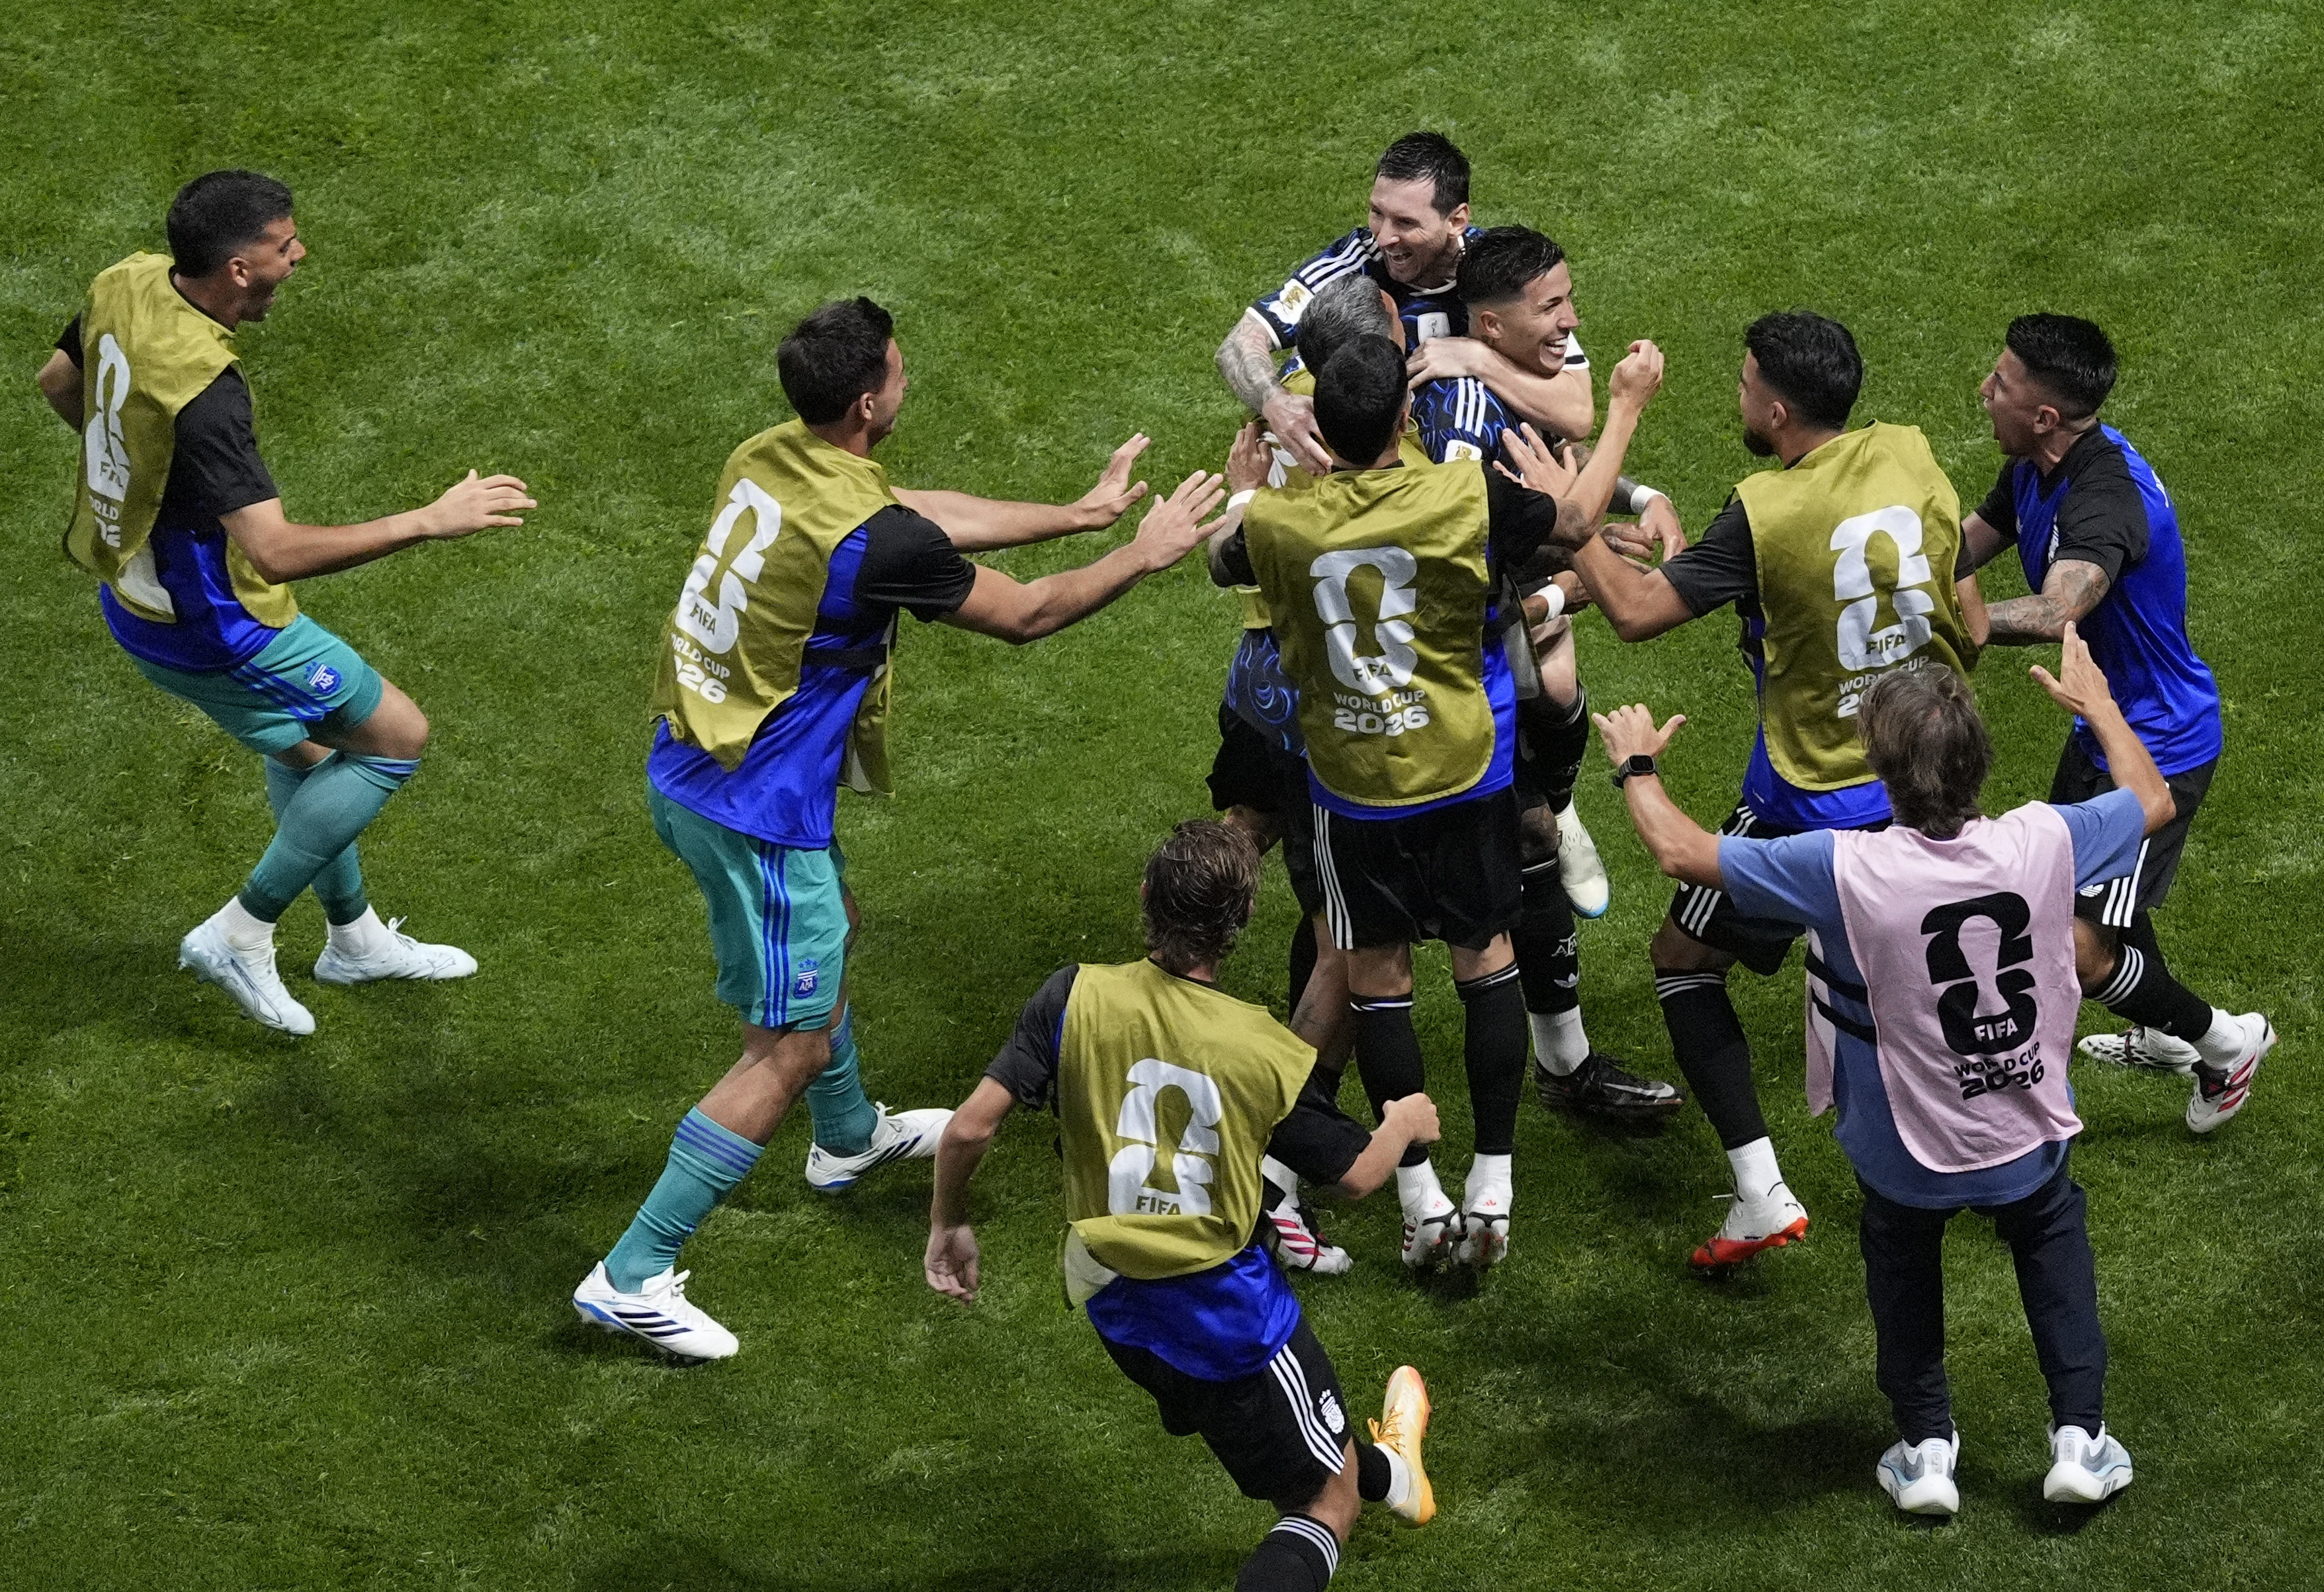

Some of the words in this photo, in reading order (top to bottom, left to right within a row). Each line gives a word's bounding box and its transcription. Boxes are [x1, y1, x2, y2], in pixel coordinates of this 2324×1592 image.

[89, 495, 119, 521] RLD
[689, 602, 717, 635] FIFA
[671, 633, 702, 663] RLD
[704, 657, 730, 680] CUP
[1866, 635, 1905, 654] FIFA
[674, 654, 728, 704] 26
[1353, 662, 1393, 682] FIFA
[1838, 674, 1885, 695] WOR
[1333, 692, 1393, 713] WORLD
[1392, 689, 1425, 708] CUP
[1334, 705, 1430, 736] 2026
[1974, 1018, 2018, 1041] FIFA
[1954, 1058, 2016, 1077] WORD
[2019, 1041, 2040, 1066] CUP
[1959, 1059, 2044, 1100] 2026
[1136, 1196, 1181, 1215] FIFA
